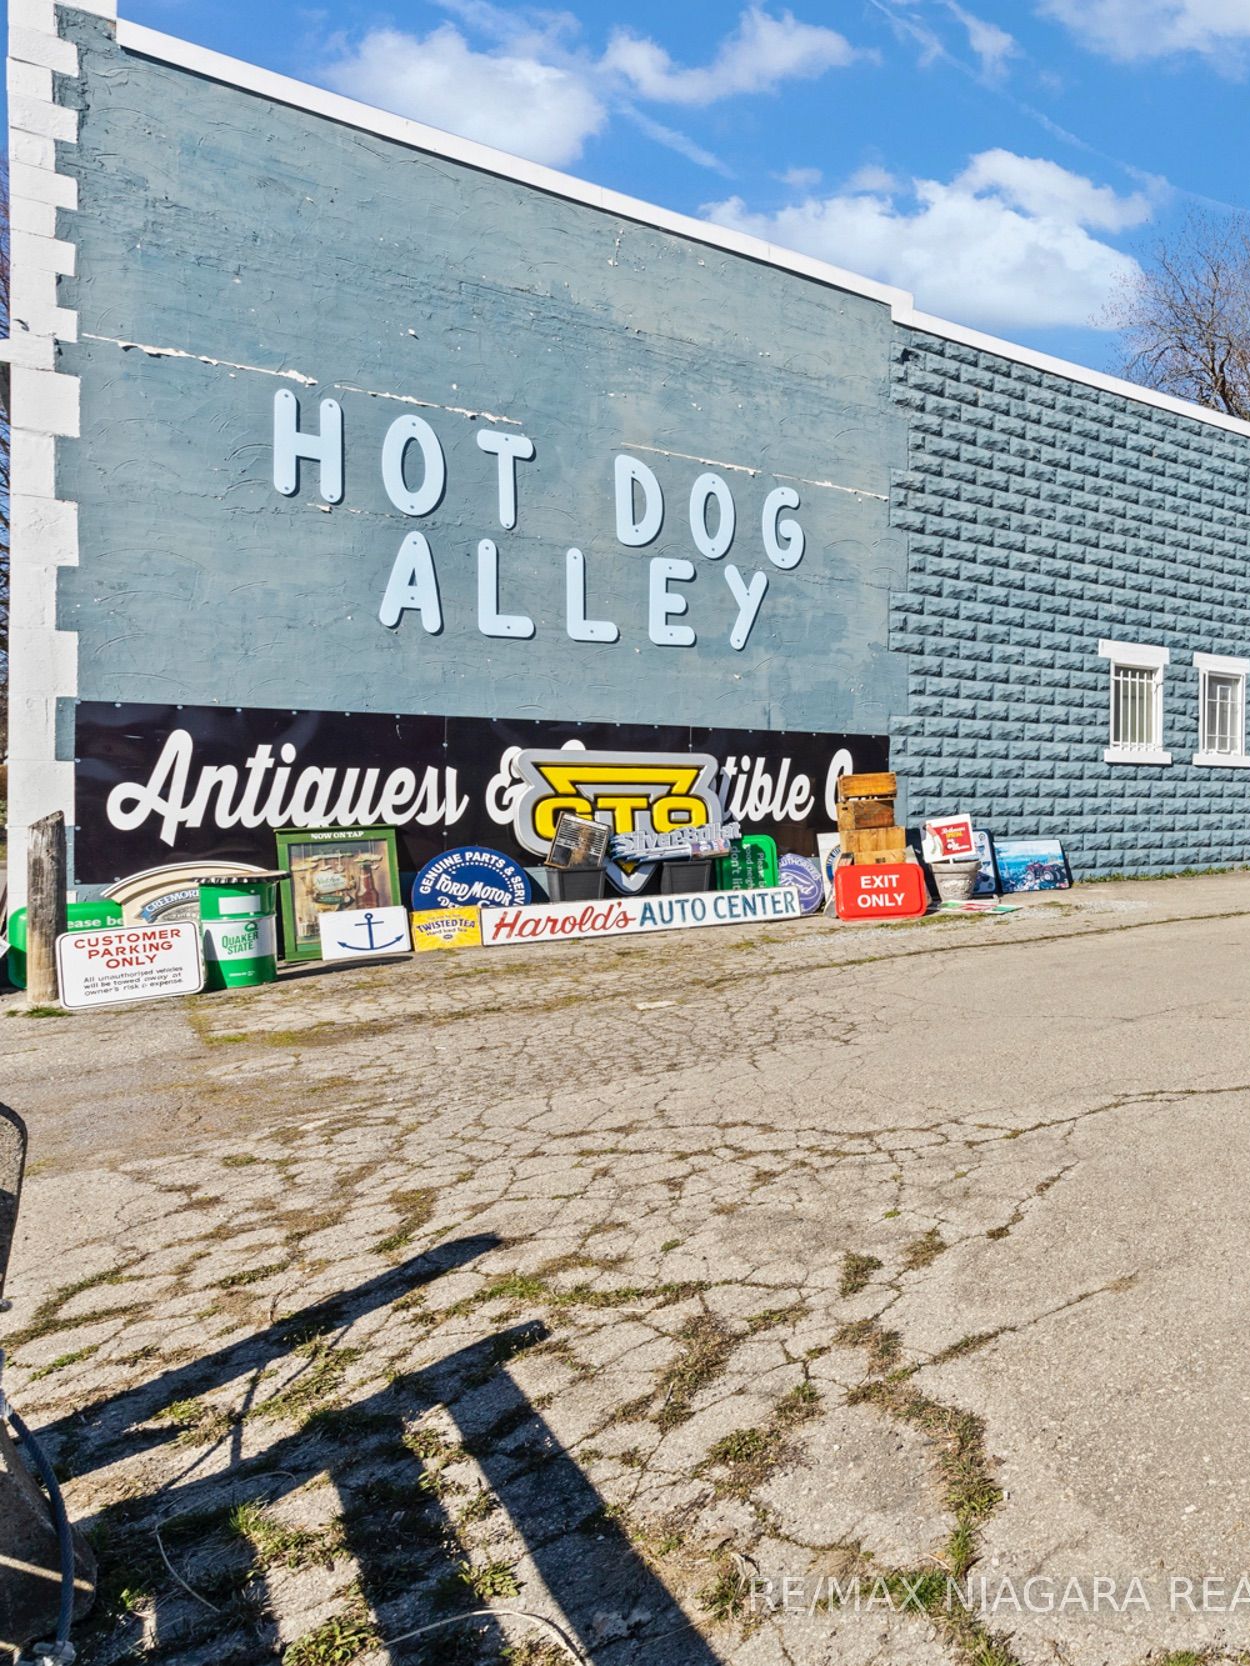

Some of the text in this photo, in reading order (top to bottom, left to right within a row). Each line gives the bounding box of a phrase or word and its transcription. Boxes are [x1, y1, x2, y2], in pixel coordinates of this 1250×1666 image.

[274, 389, 804, 570] HOT DOG
[379, 531, 767, 651] ALLEY
[534, 796, 709, 842] GTO
[311, 830, 365, 840] NOW ON TAP
[731, 846, 743, 875] don't
[420, 853, 463, 895] GENUINE
[464, 851, 506, 869] PARTS
[504, 866, 516, 877] &
[859, 874, 900, 890] EXIT
[457, 881, 513, 907] MOTOR
[856, 893, 906, 909] ONLY
[66, 918, 102, 929] ease
[491, 901, 637, 940] Harold's
[639, 897, 707, 928] AUTO
[714, 890, 798, 919] CENTER
[416, 918, 476, 933] TWISTED TEA
[74, 928, 182, 949] CUSTOMER
[222, 931, 259, 948] QUAKER
[88, 940, 173, 960] PARKING
[228, 941, 255, 955] STATE
[105, 954, 157, 969] ONLY
[156, 966, 183, 974] vehicles
[83, 982, 99, 990] will
[113, 978, 141, 986] towed
[144, 974, 168, 982] away
